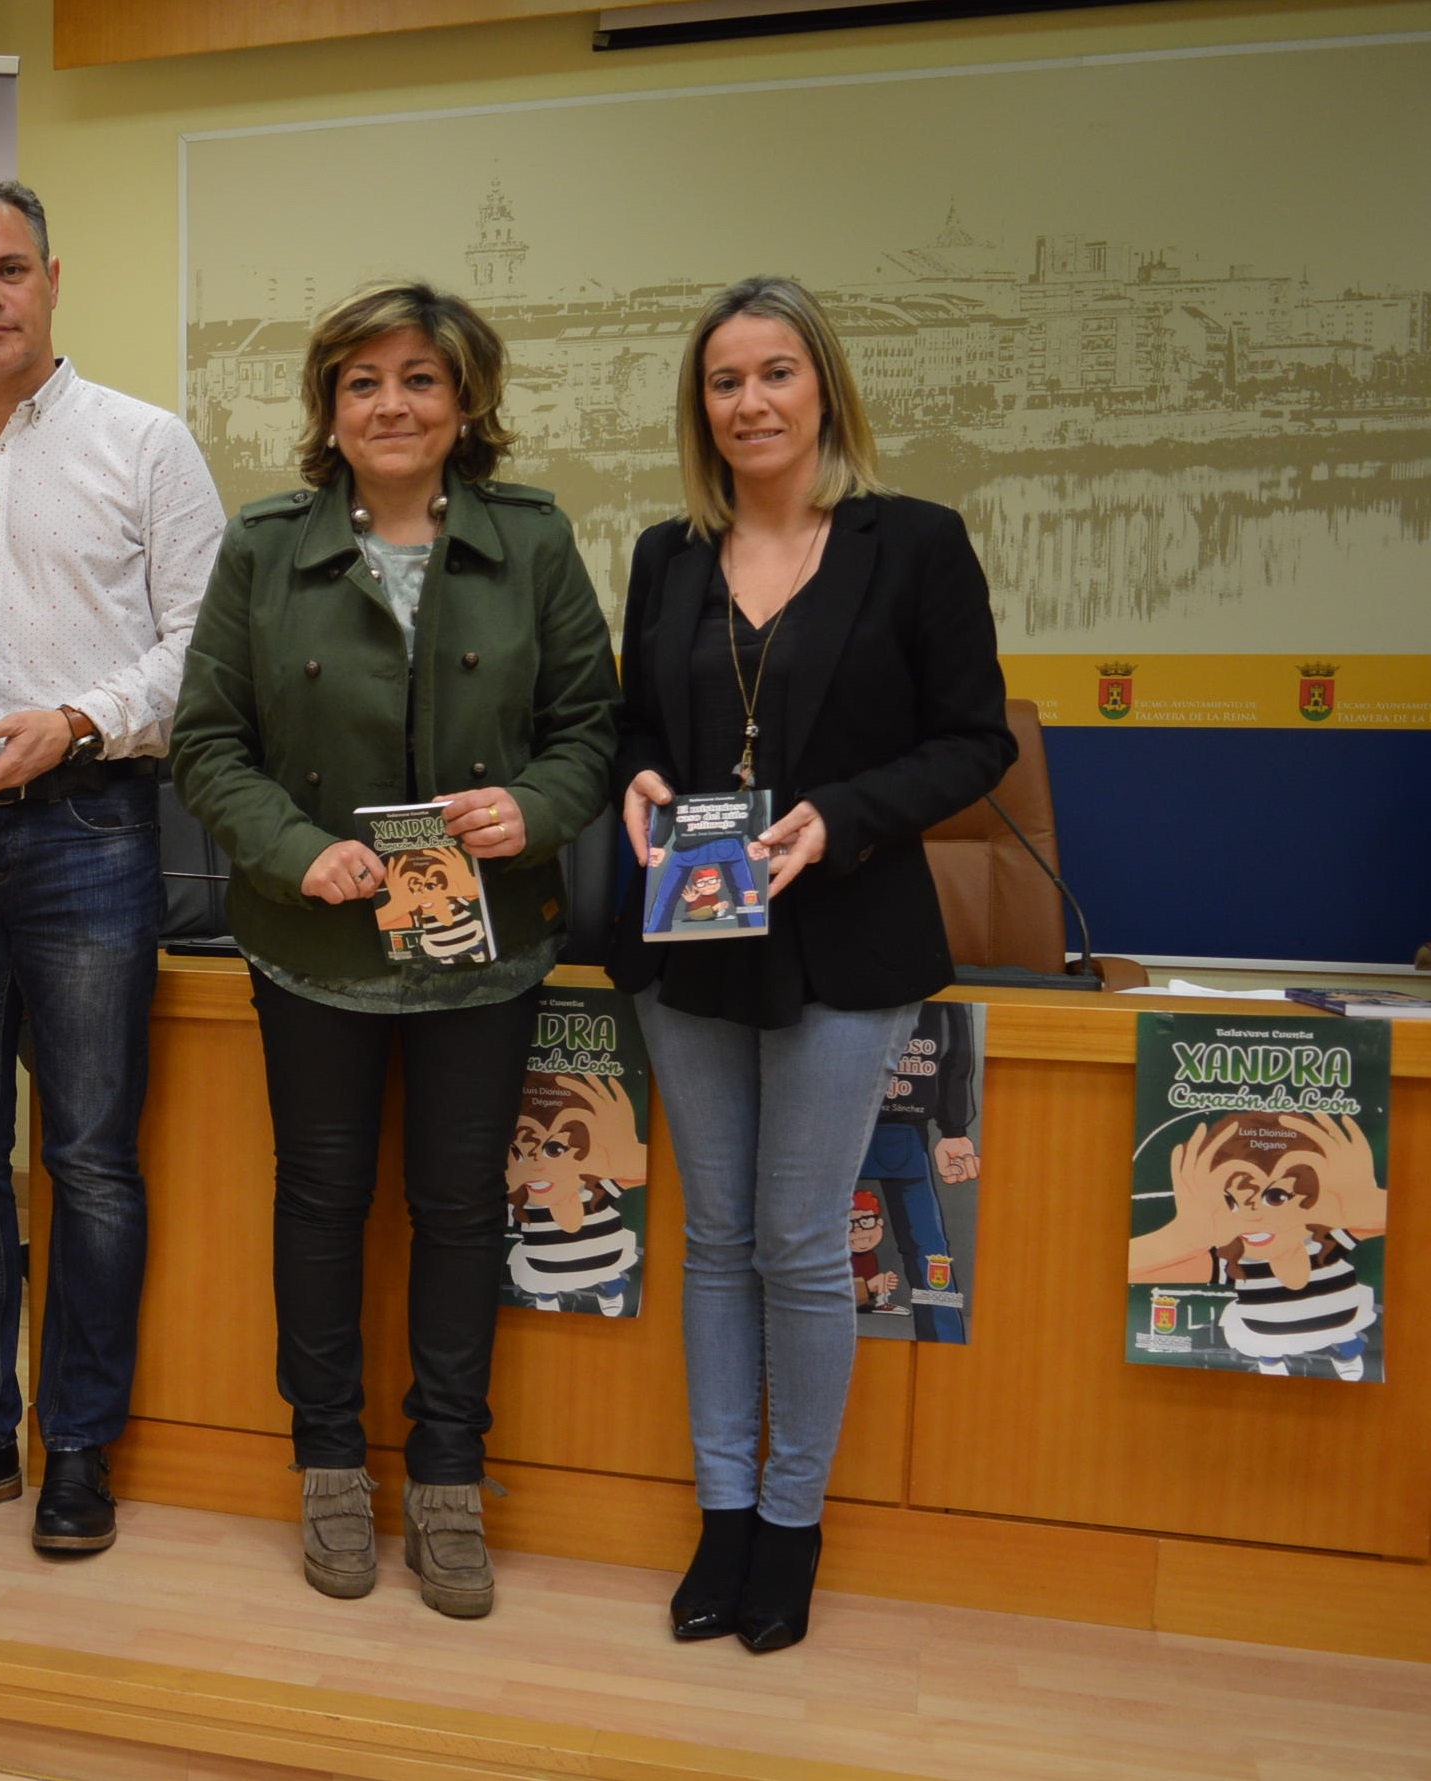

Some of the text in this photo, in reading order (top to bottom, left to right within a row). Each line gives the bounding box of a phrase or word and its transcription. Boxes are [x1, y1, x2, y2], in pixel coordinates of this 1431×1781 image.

[1039, 712, 1059, 720] INA
[1134, 711, 1257, 721] TALAVERA DE LA REINA
[370, 816, 445, 839] XANDRA
[537, 1013, 616, 1051] DRA
[1215, 1028, 1314, 1039] Talavera Cuenta
[542, 1048, 568, 1073] de
[570, 1051, 624, 1076] León
[897, 1056, 937, 1076] iño
[1172, 1042, 1351, 1088] XANDRA
[522, 1086, 571, 1097] Luis Dionisio
[1168, 1083, 1361, 1115] Corazón de León
[1238, 1127, 1297, 1138] Luis Dionisio
[1250, 1139, 1287, 1151] Dégano
